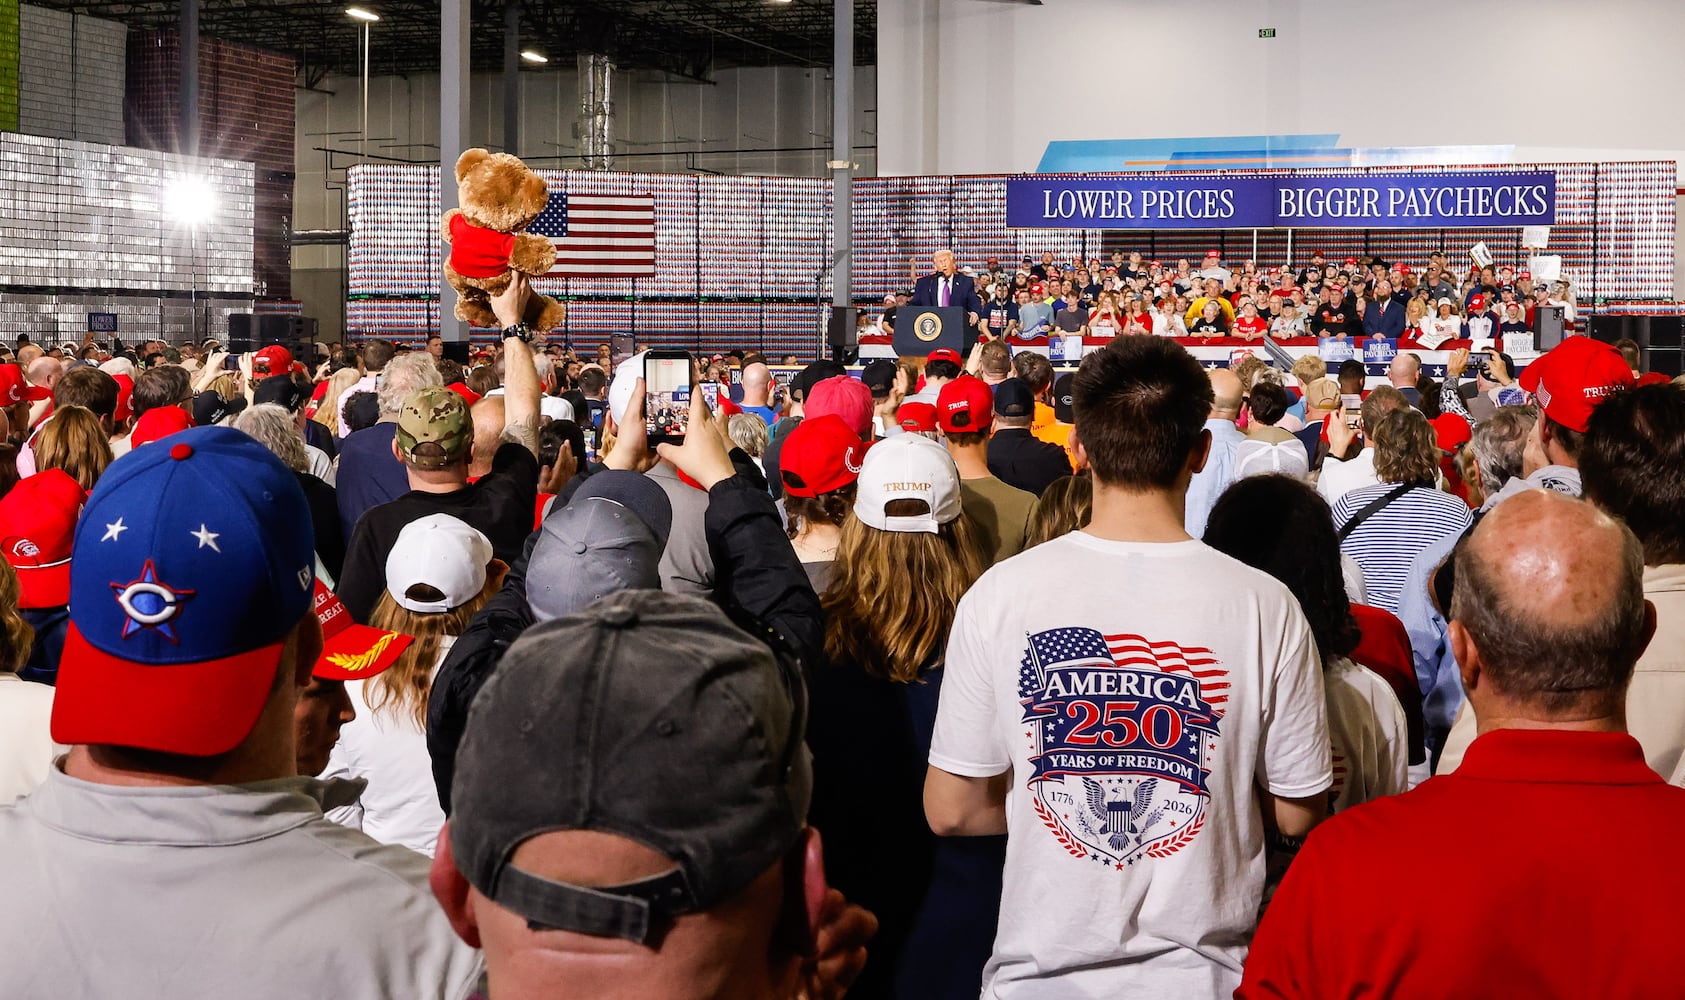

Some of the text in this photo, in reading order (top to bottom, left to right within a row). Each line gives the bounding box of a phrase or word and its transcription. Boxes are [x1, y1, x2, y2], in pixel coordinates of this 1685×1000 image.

[1261, 29, 1274, 38] EXIT
[1043, 188, 1235, 219] LOWER PRICES
[1278, 185, 1548, 218] BIGGER PAYCHECKS
[91, 315, 114, 323] LOWER
[1364, 349, 1396, 358] PAYCHECKS
[1506, 345, 1532, 353] PAYCHEC
[884, 482, 932, 491] TRUMP
[318, 602, 343, 624] REAT
[1041, 671, 1200, 711] AMERICA
[1064, 700, 1183, 749] 250
[1048, 754, 1194, 780] YEARS OF FREEDOM
[1050, 791, 1193, 815] 1776 2026
